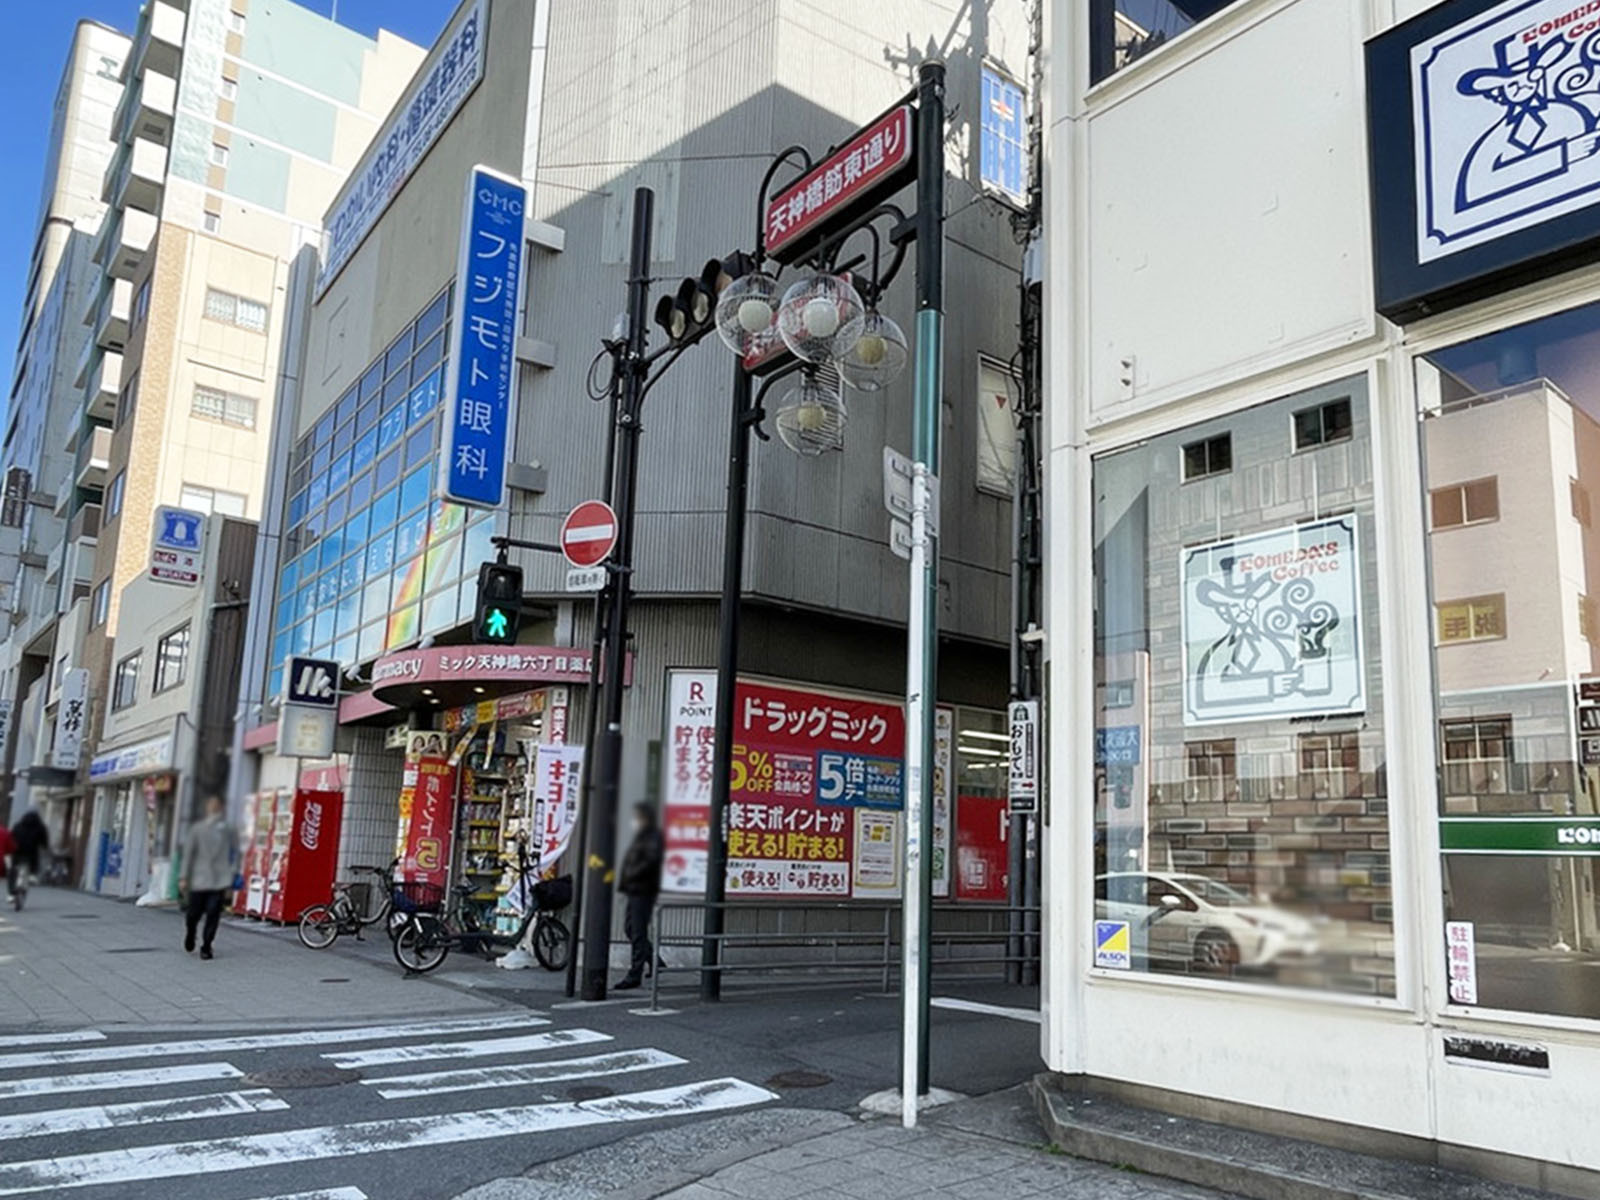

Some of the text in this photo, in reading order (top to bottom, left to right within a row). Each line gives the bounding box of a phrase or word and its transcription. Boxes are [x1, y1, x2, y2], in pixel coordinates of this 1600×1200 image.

[1567, 18, 1600, 39] Co
[769, 119, 901, 241] 天神橋筋東通り
[478, 188, 523, 216] CMC
[456, 230, 506, 480] フジモト眼科
[1240, 541, 1338, 573] KOMEDA'S
[1273, 559, 1340, 581] Coffee
[690, 681, 705, 701] R
[680, 706, 713, 717] POINT
[743, 697, 888, 745] ドラッグミック
[747, 776, 774, 794] OFF
[729, 801, 846, 833] 楽天ポイントが
[1451, 926, 1473, 1001] 駐輪禁止
